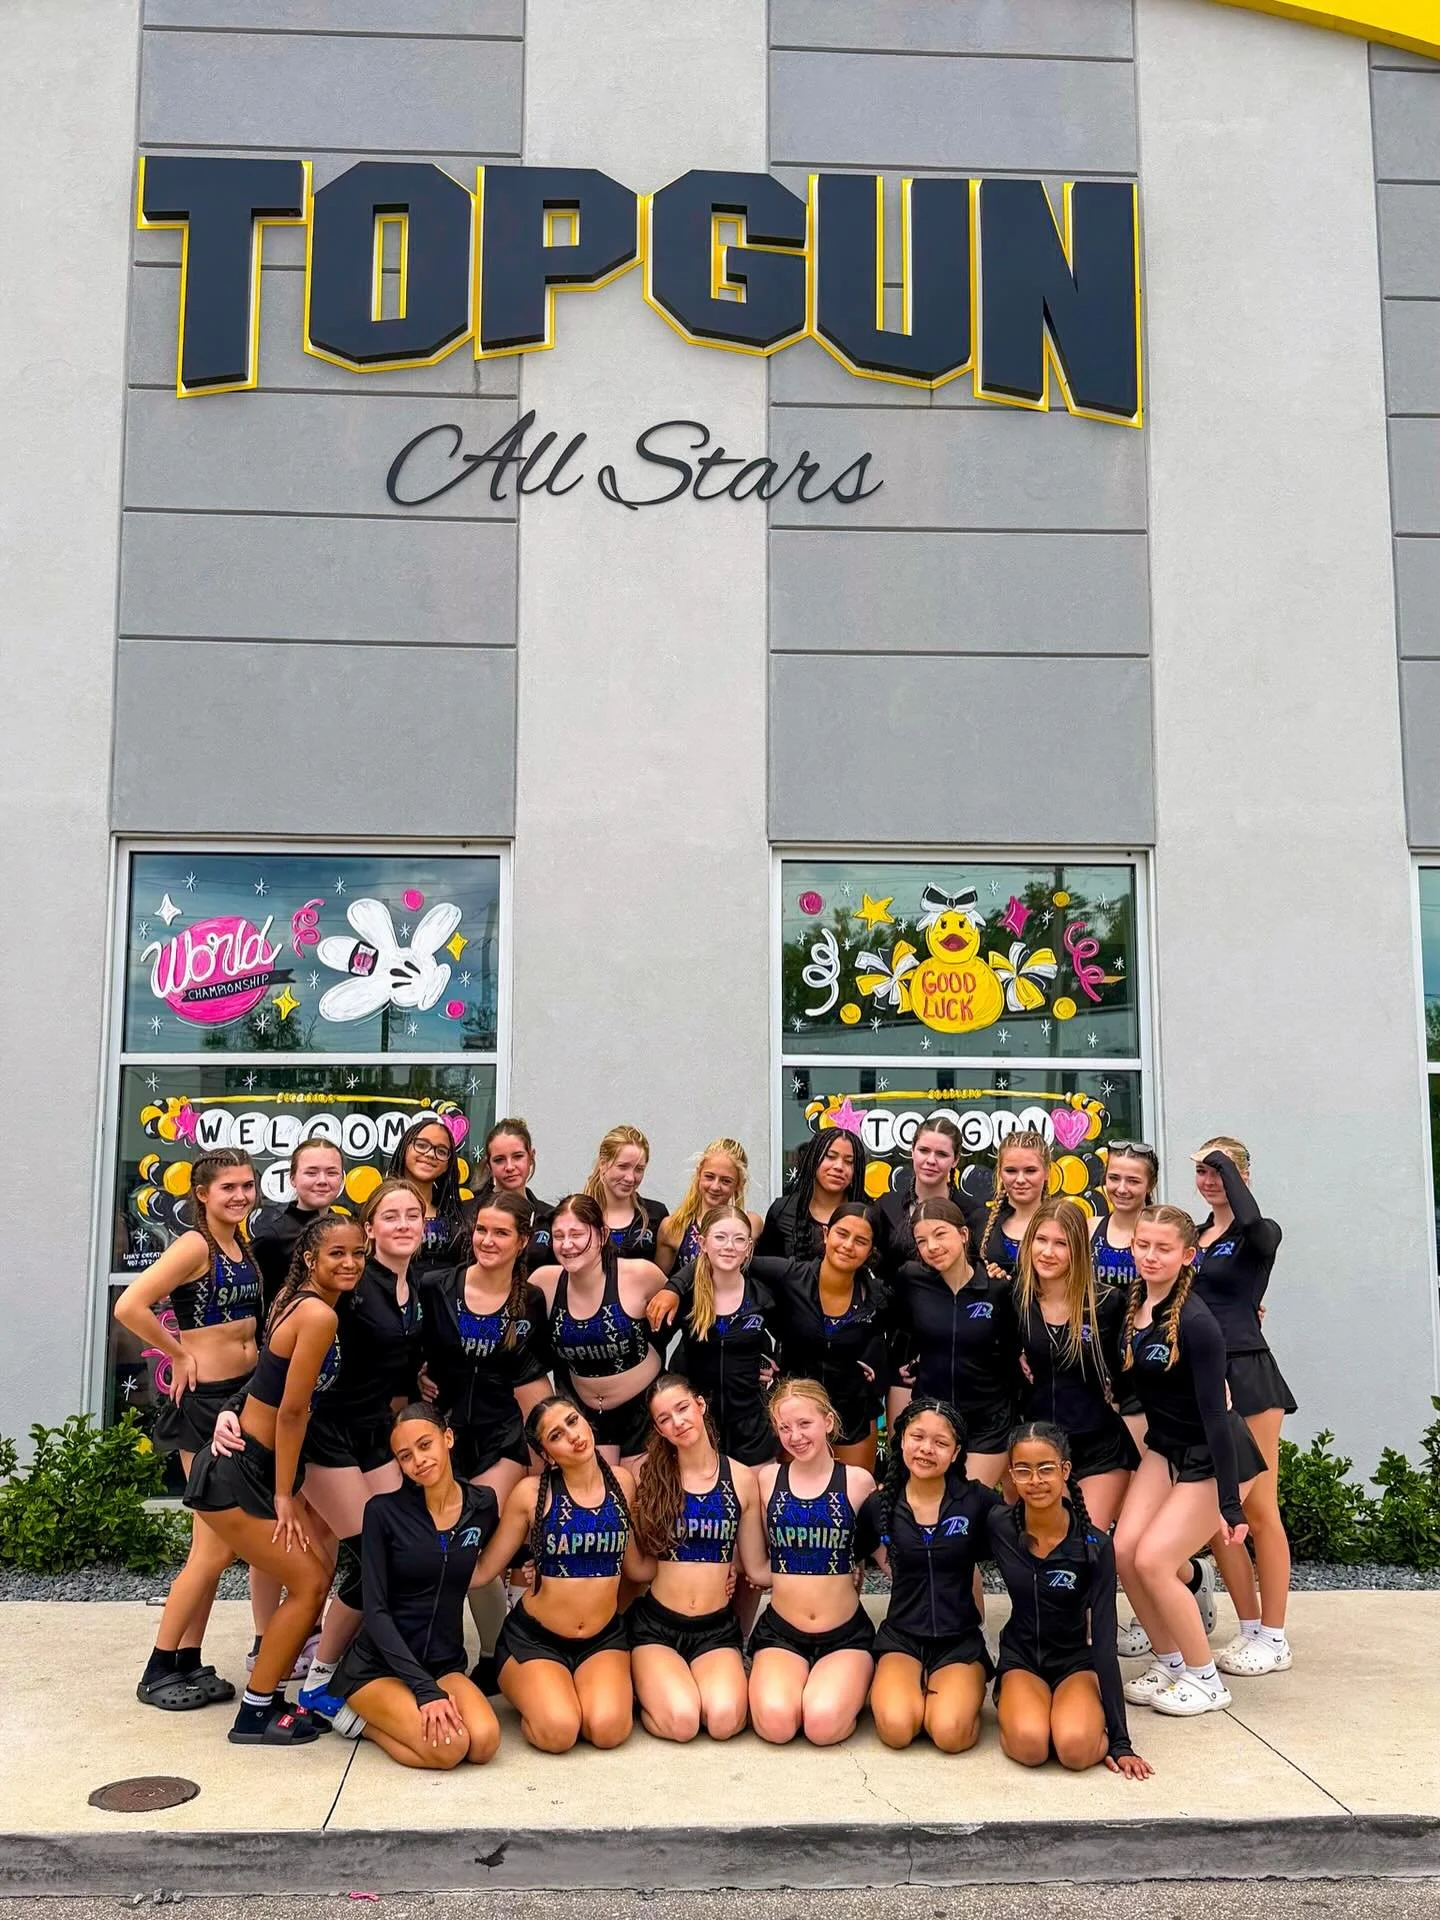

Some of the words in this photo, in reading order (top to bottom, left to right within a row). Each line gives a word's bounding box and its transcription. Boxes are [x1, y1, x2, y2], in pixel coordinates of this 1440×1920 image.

[138, 155, 1144, 429] TOPGUN
[386, 409, 587, 506] All
[598, 420, 884, 511] Stars
[140, 915, 283, 999] World
[188, 973, 270, 1000] CHAMPIONSHIP
[921, 969, 976, 996] GOOD
[923, 994, 974, 1022] LUCK
[199, 1117, 438, 1149] WELCOM
[867, 1116, 1047, 1147] TOGUN
[546, 1531, 629, 1555] SAPPHIR
